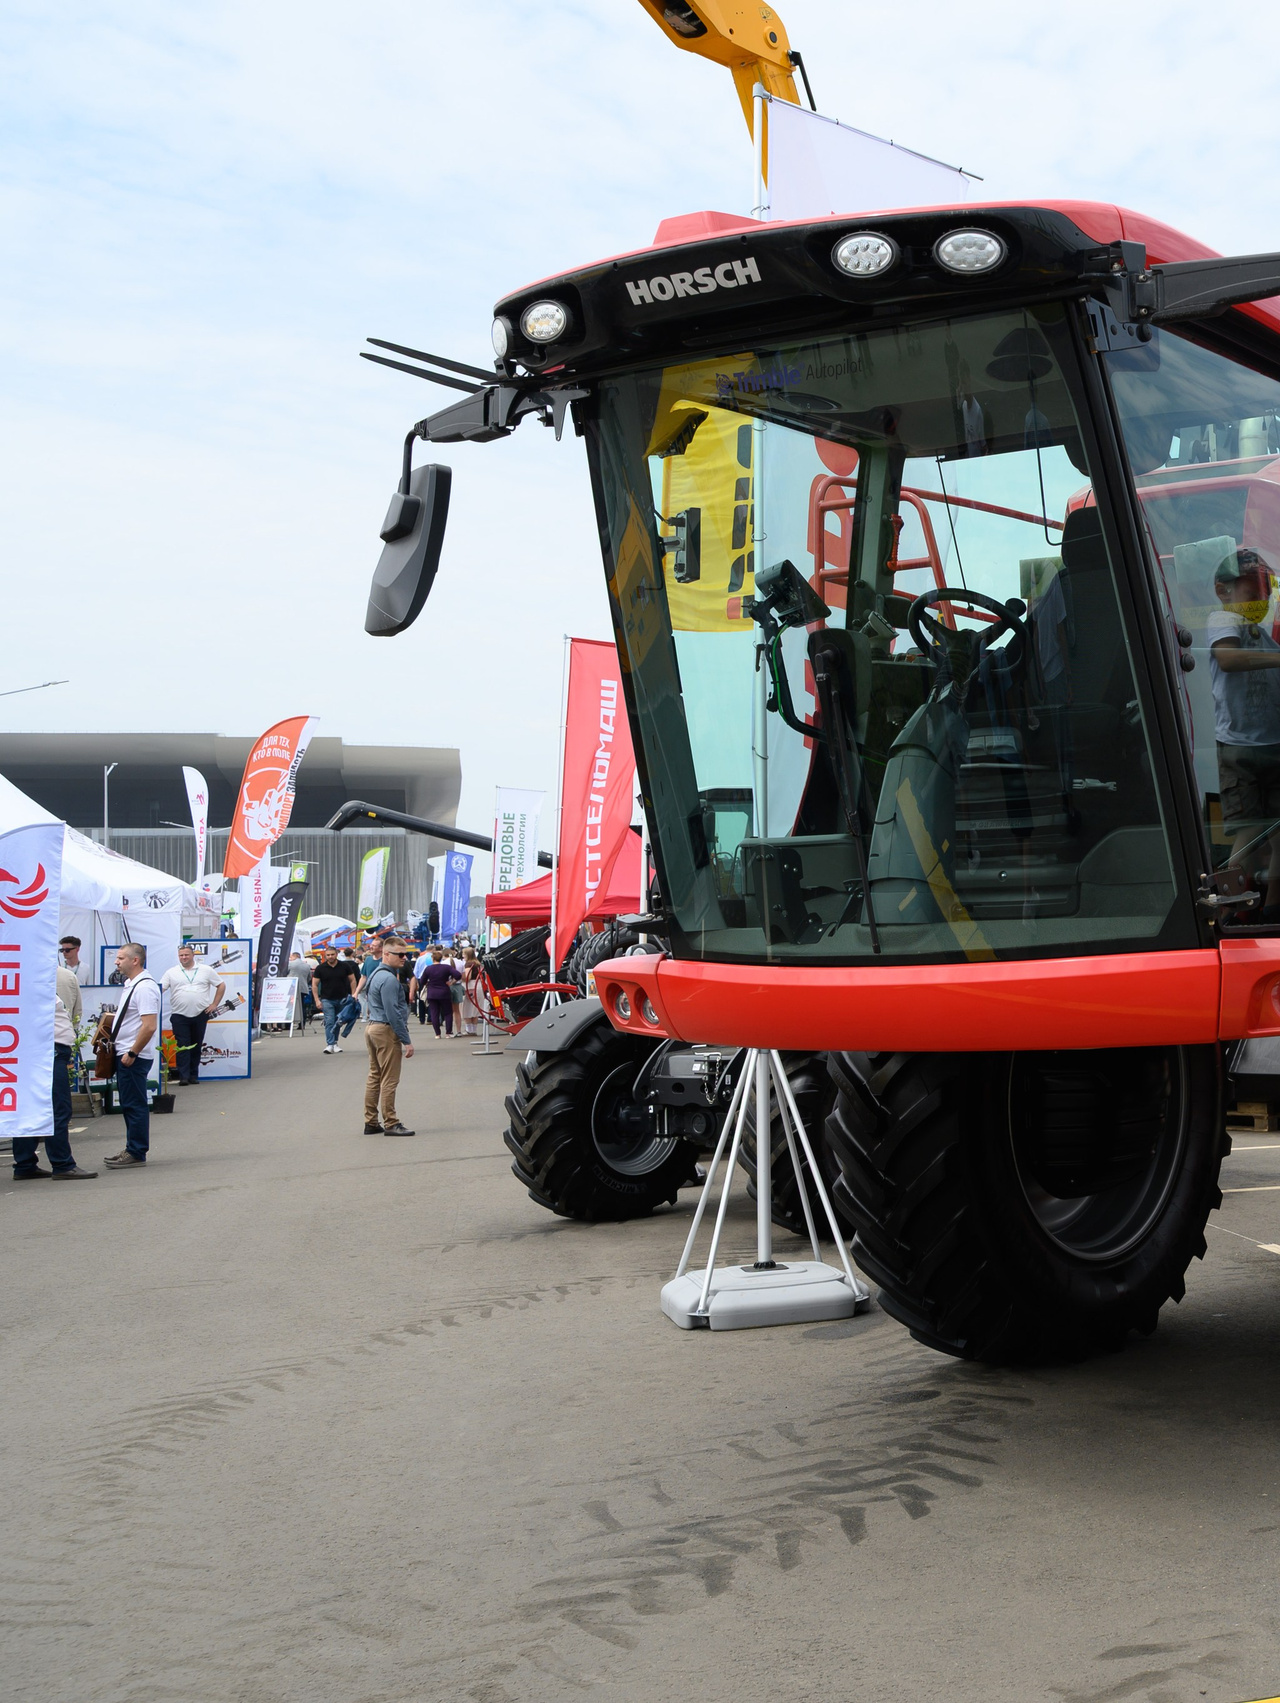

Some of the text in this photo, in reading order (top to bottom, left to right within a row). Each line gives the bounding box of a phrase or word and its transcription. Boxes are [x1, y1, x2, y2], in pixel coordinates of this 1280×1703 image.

[626, 257, 762, 306] HORSCH
[733, 357, 862, 393] Trimble Autopilot
[252, 748, 291, 762] КТО В ПОЛЕ
[262, 735, 278, 748] ДЛЯ
[585, 679, 618, 909] СТСЕЛЬМАШ
[499, 812, 515, 892] ЕРЕДОВЫЕ
[516, 813, 527, 888] отехнологии
[254, 869, 262, 928] MM-SHN
[274, 897, 293, 934] ПАРК
